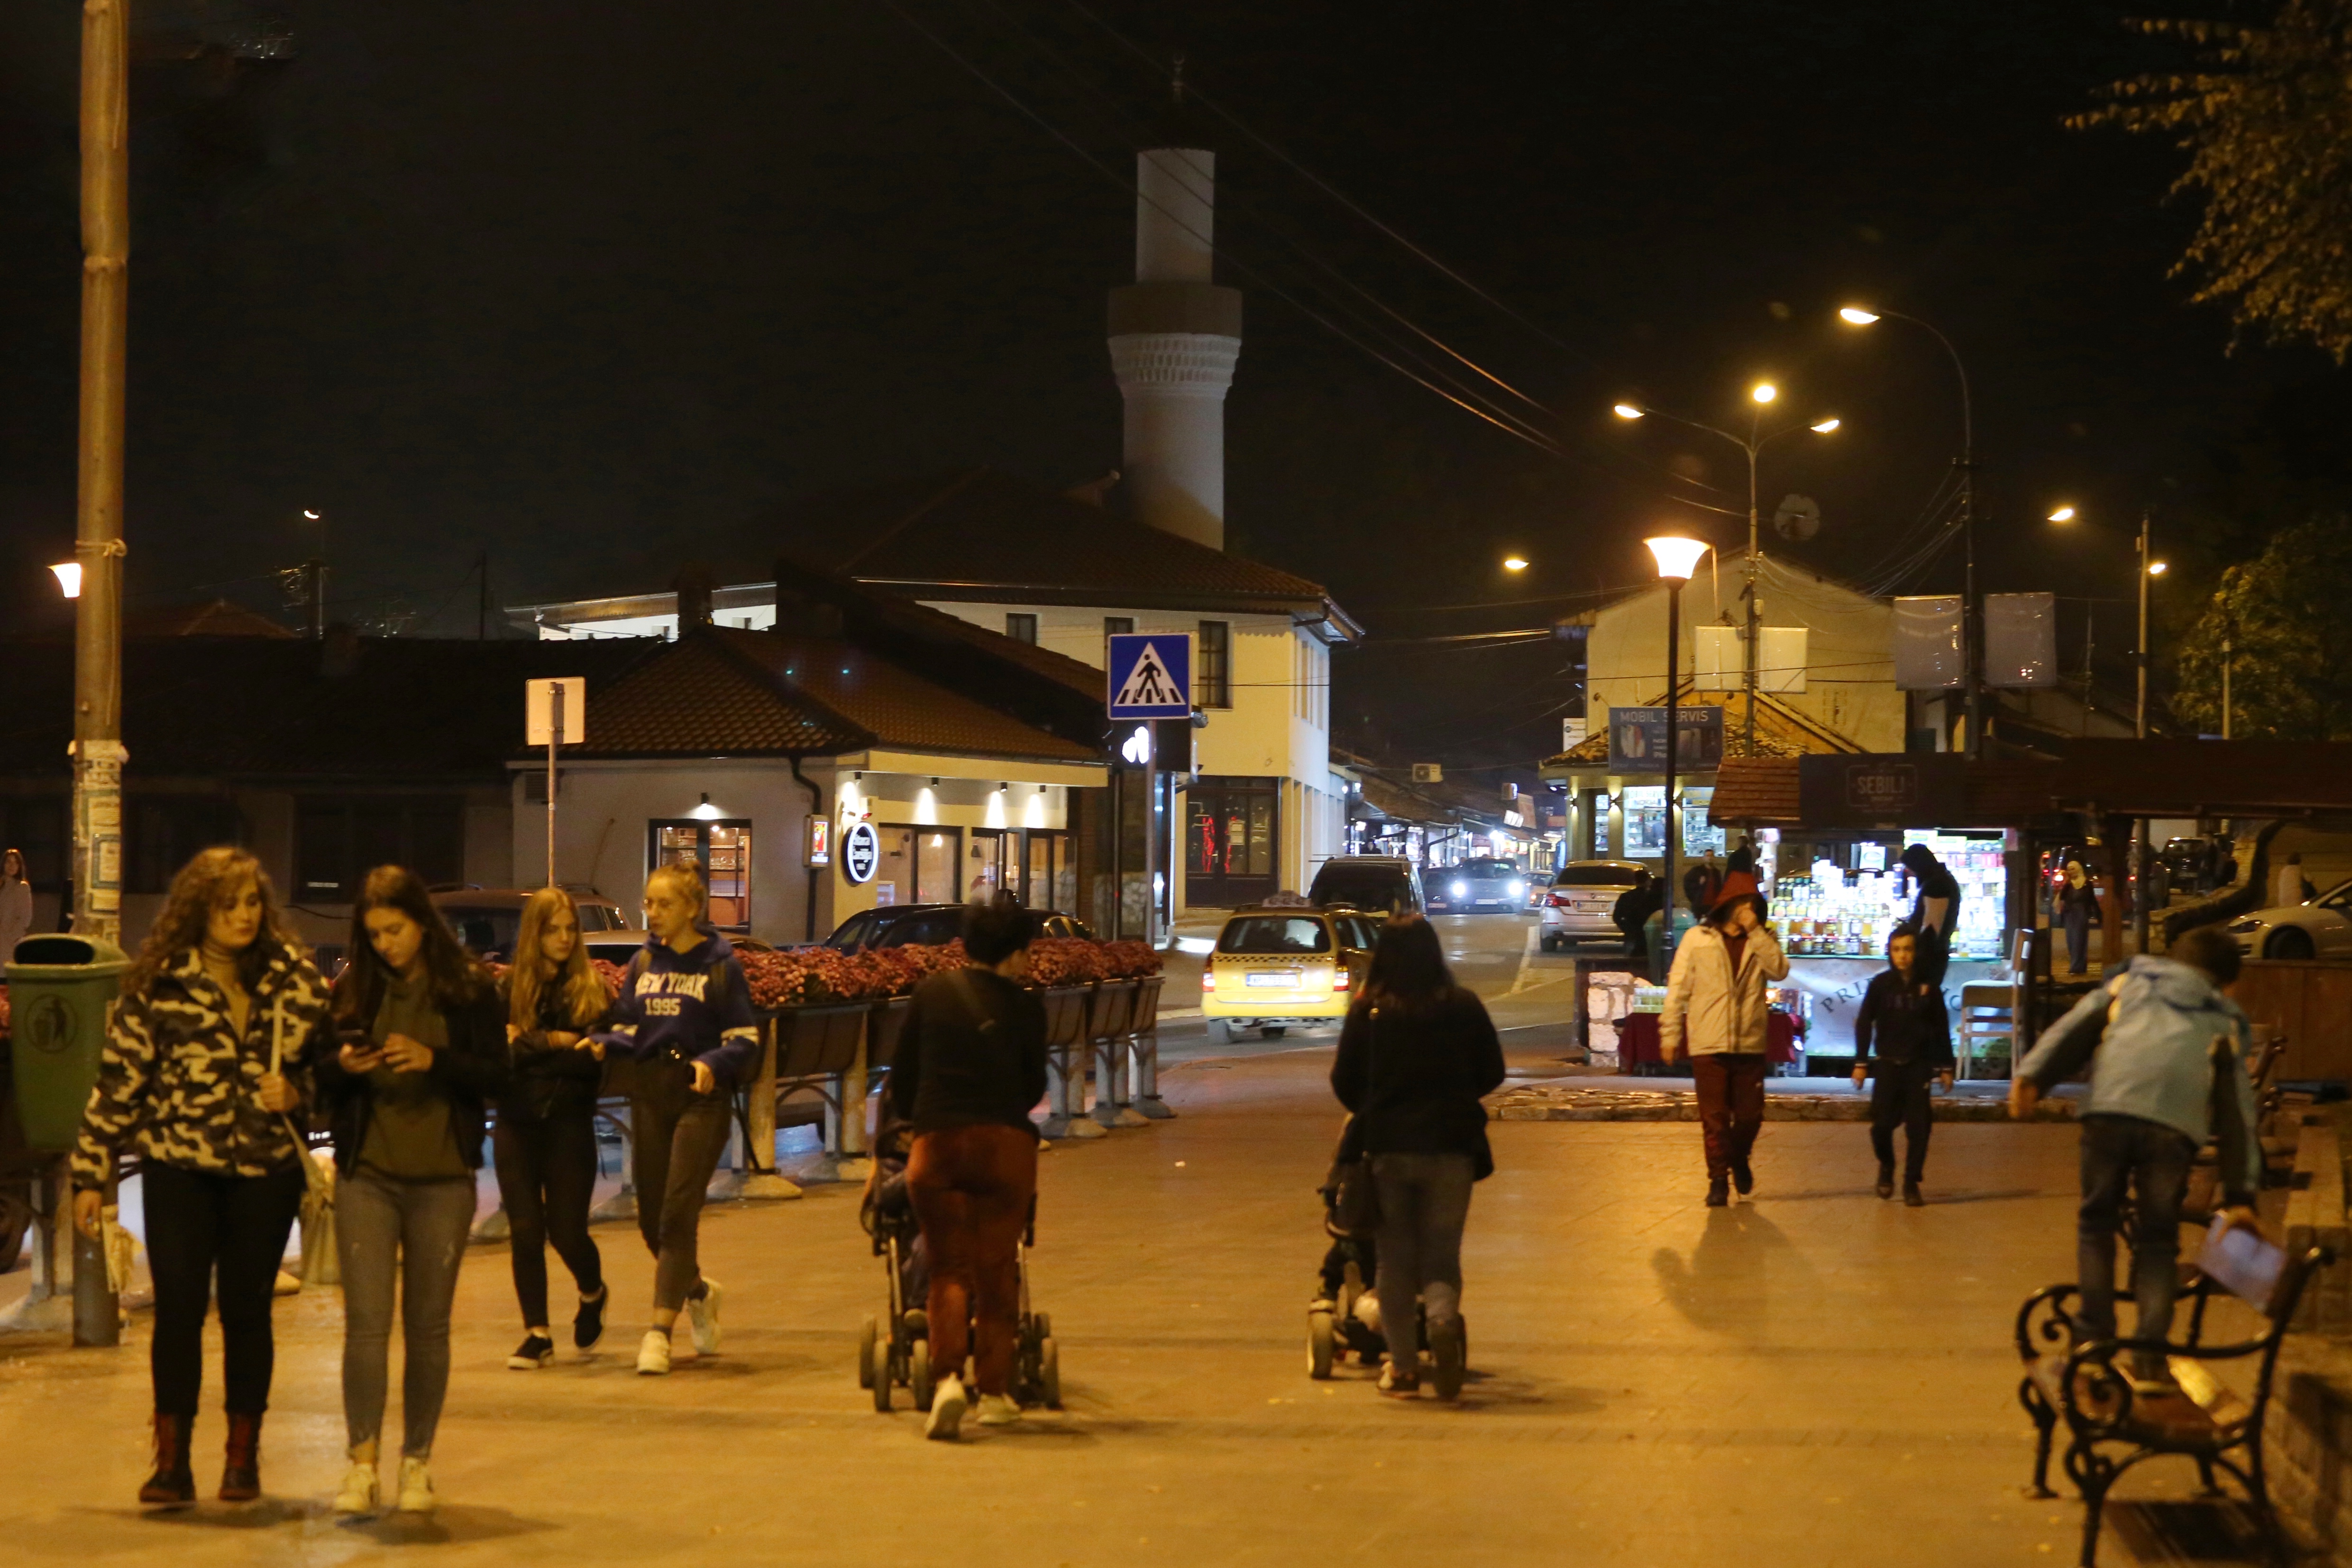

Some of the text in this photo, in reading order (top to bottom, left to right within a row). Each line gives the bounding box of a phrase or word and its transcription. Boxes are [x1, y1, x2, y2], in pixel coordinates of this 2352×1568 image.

[1620, 711, 1657, 723] MOBIL
[1858, 776, 1905, 794] SEBILJ
[666, 972, 709, 1003] YORK
